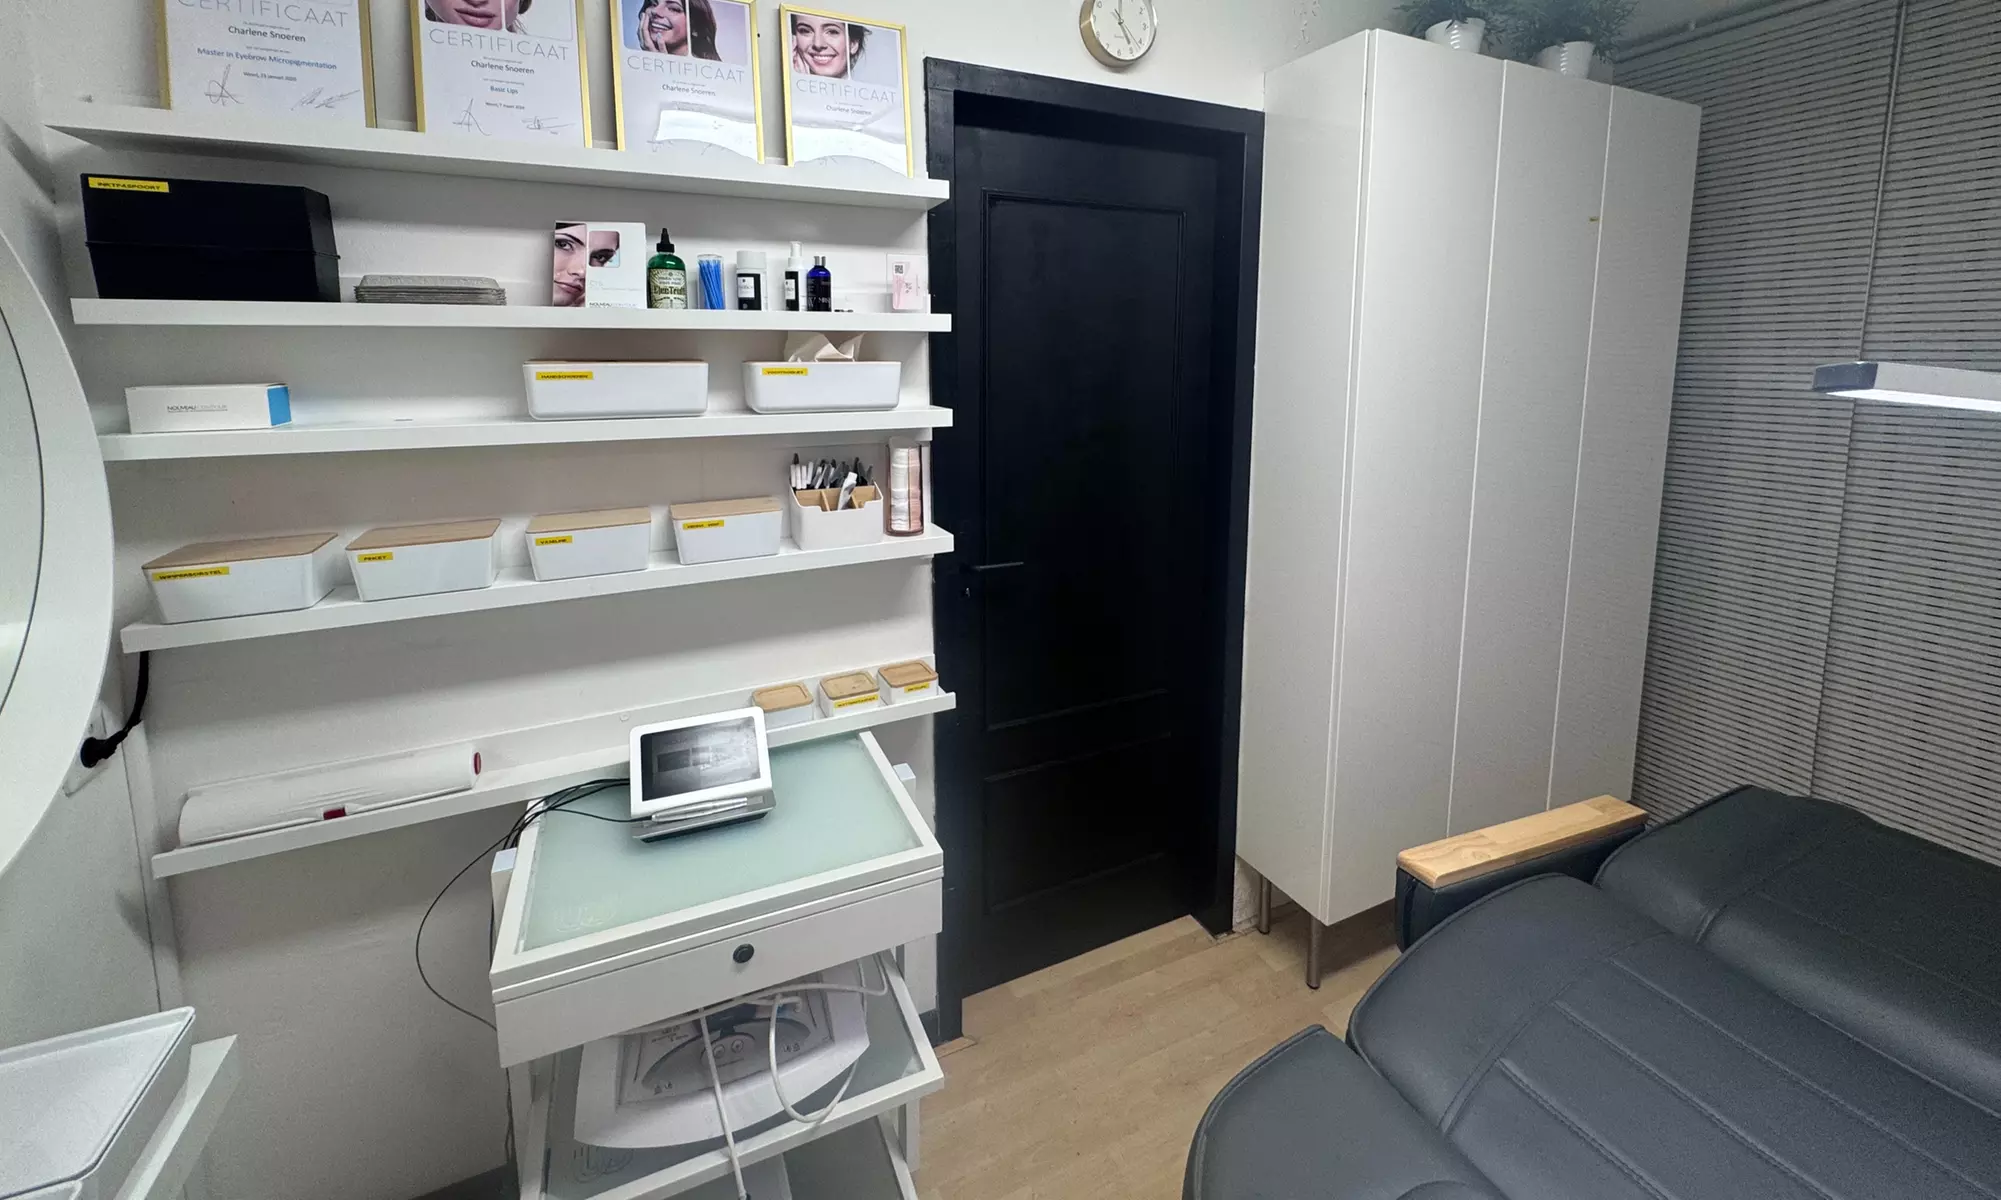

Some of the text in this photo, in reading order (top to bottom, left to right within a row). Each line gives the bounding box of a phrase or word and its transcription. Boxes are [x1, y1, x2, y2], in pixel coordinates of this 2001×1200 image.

[228, 25, 268, 38] Charlene
[270, 31, 306, 43] Snoeren
[429, 28, 569, 61] CERTIFICAAT
[197, 47, 225, 58] Master
[235, 52, 267, 62] Eyebrow
[268, 55, 337, 70] Micropigmentation
[470, 60, 504, 71] Charlene
[505, 64, 535, 75] Snoeren
[627, 55, 745, 84] CERTIFICAAT
[661, 83, 690, 94] Charlene
[691, 87, 716, 96] Snoeren
[796, 78, 897, 104] CERTIFICAAT
